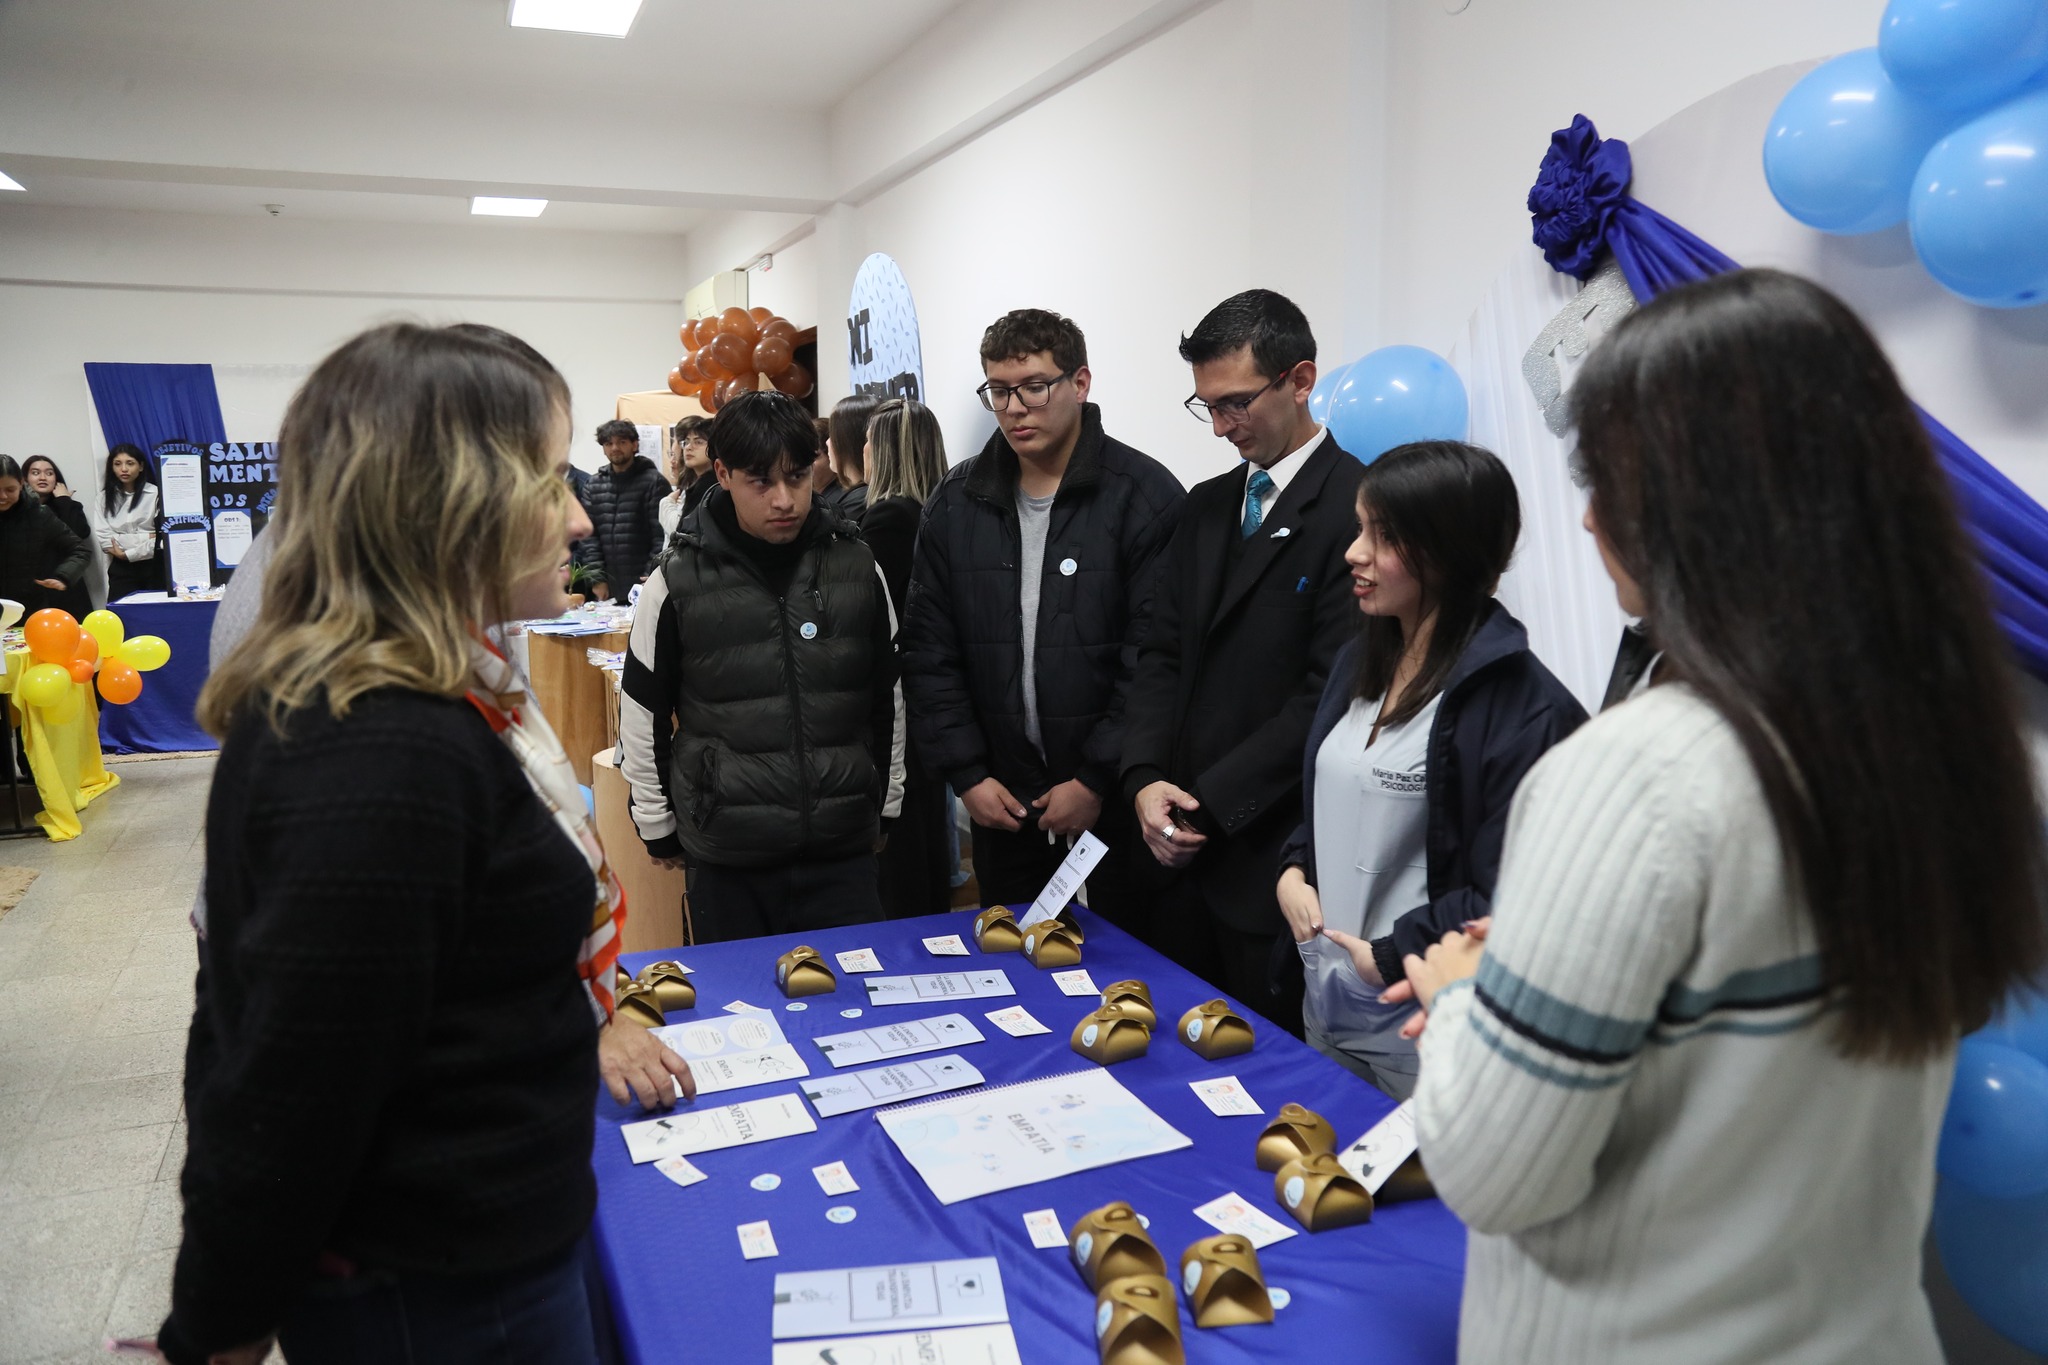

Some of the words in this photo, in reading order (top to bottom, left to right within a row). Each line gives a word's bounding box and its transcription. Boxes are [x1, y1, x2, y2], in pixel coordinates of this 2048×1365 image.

[153, 443, 204, 457] OBJETIVOS
[209, 442, 279, 462] SALU
[209, 463, 279, 483] MENT
[1396, 773, 1411, 782] Paz
[1413, 774, 1426, 783] Ca
